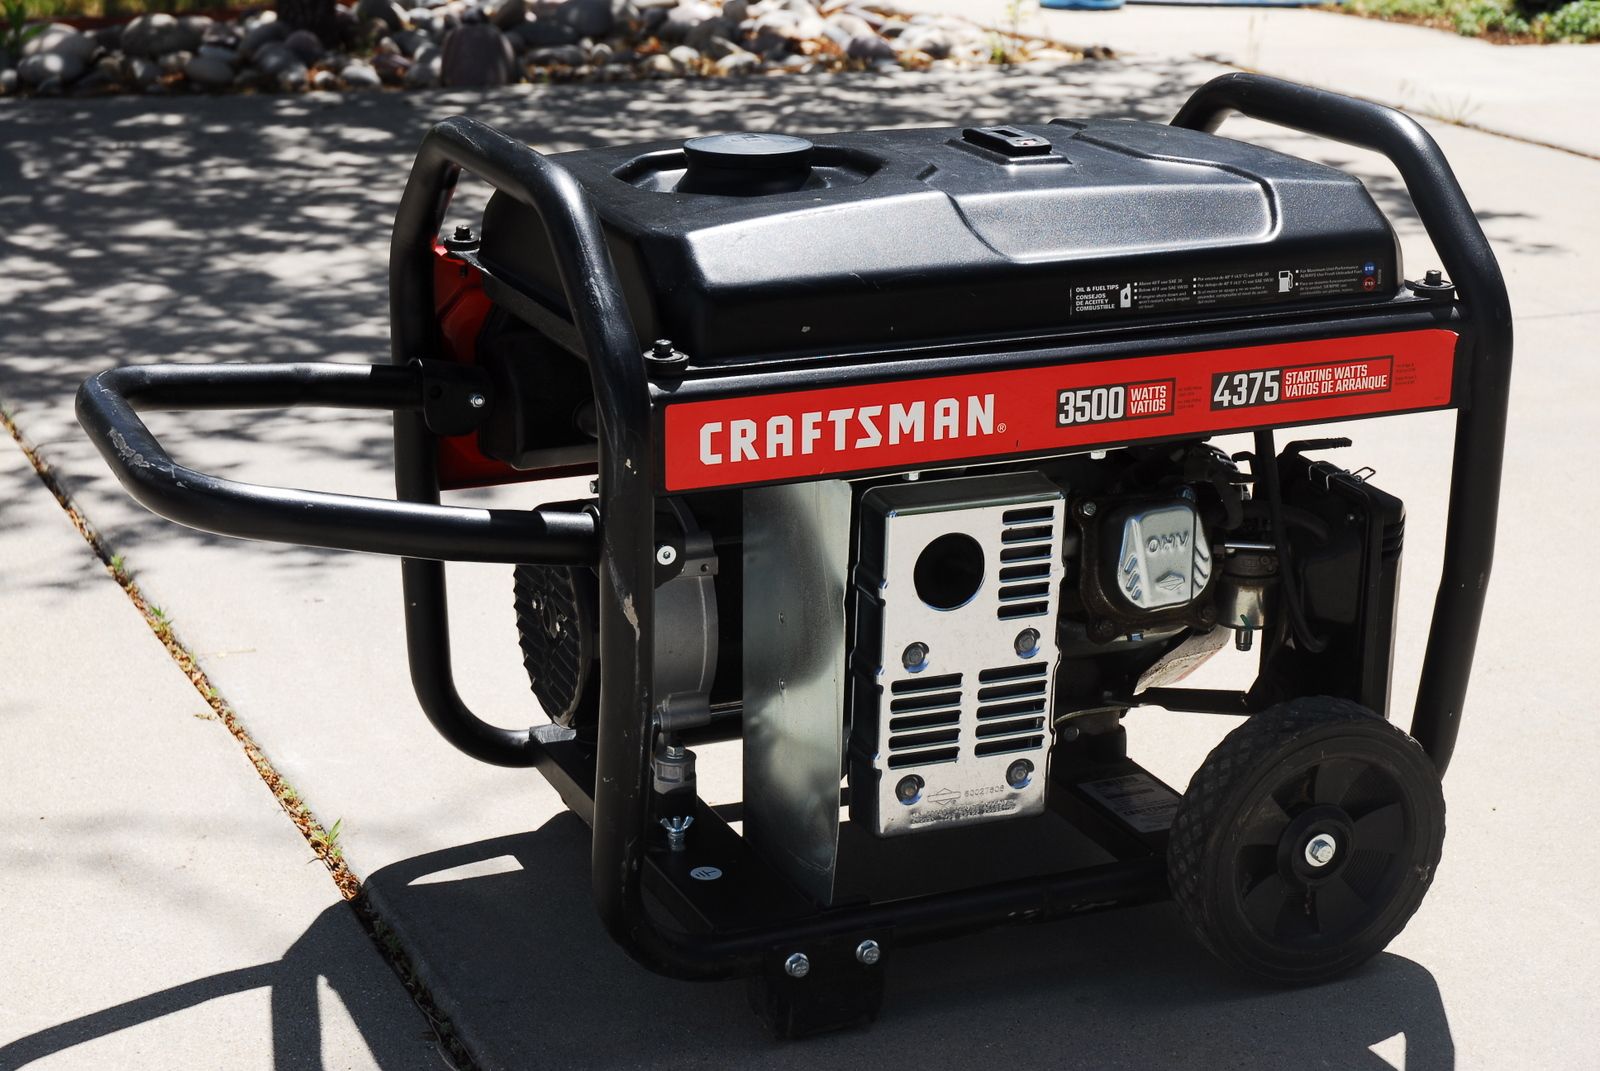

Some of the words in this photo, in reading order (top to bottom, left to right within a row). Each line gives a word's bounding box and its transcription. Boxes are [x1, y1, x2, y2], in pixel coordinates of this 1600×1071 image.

[1076, 304, 1115, 312] COMBUSTIBLE
[1286, 368, 1332, 385] STARTING
[1334, 364, 1368, 380] WATTS
[1130, 385, 1167, 401] WATTS
[1213, 370, 1280, 407] 4375
[1286, 381, 1319, 398] VATIOS
[1321, 380, 1334, 394] DE
[1336, 374, 1388, 392] ARRANQUE
[1059, 386, 1125, 425] 3500
[1130, 398, 1166, 414] VATIOS
[699, 393, 995, 465] CRAFTSMAN
